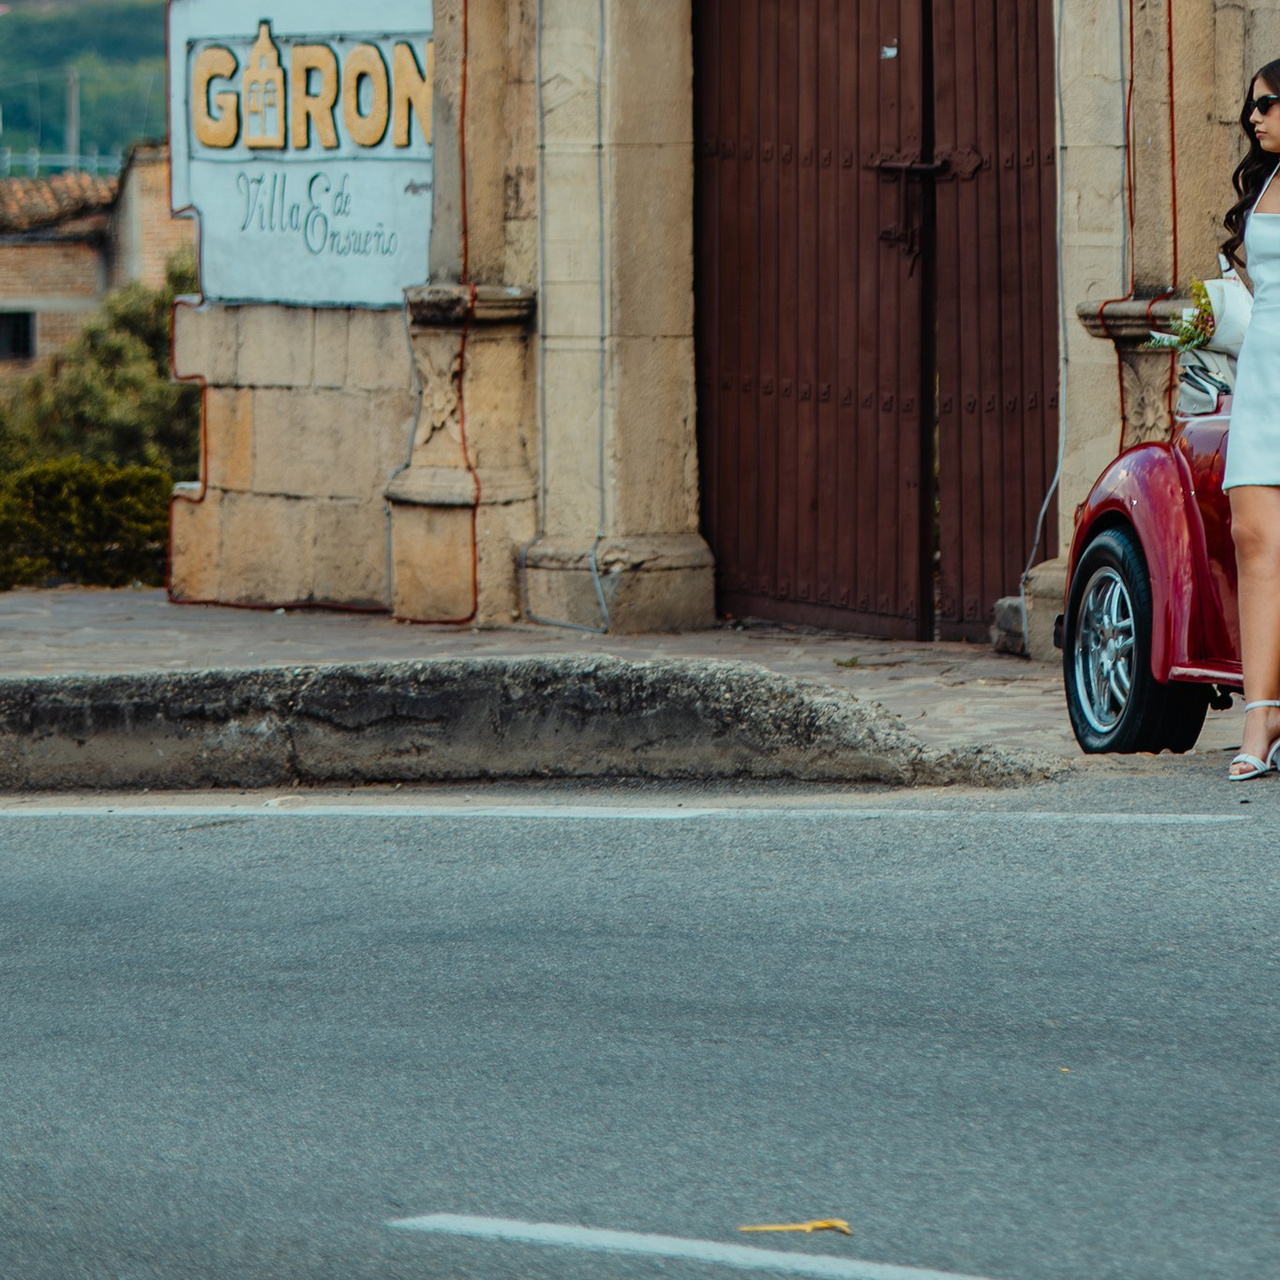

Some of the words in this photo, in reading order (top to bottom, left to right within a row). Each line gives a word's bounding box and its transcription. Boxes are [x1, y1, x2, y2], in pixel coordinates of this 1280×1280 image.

[237, 171, 300, 232] Villa
[333, 172, 351, 216] de
[304, 171, 398, 256] Ensueño
